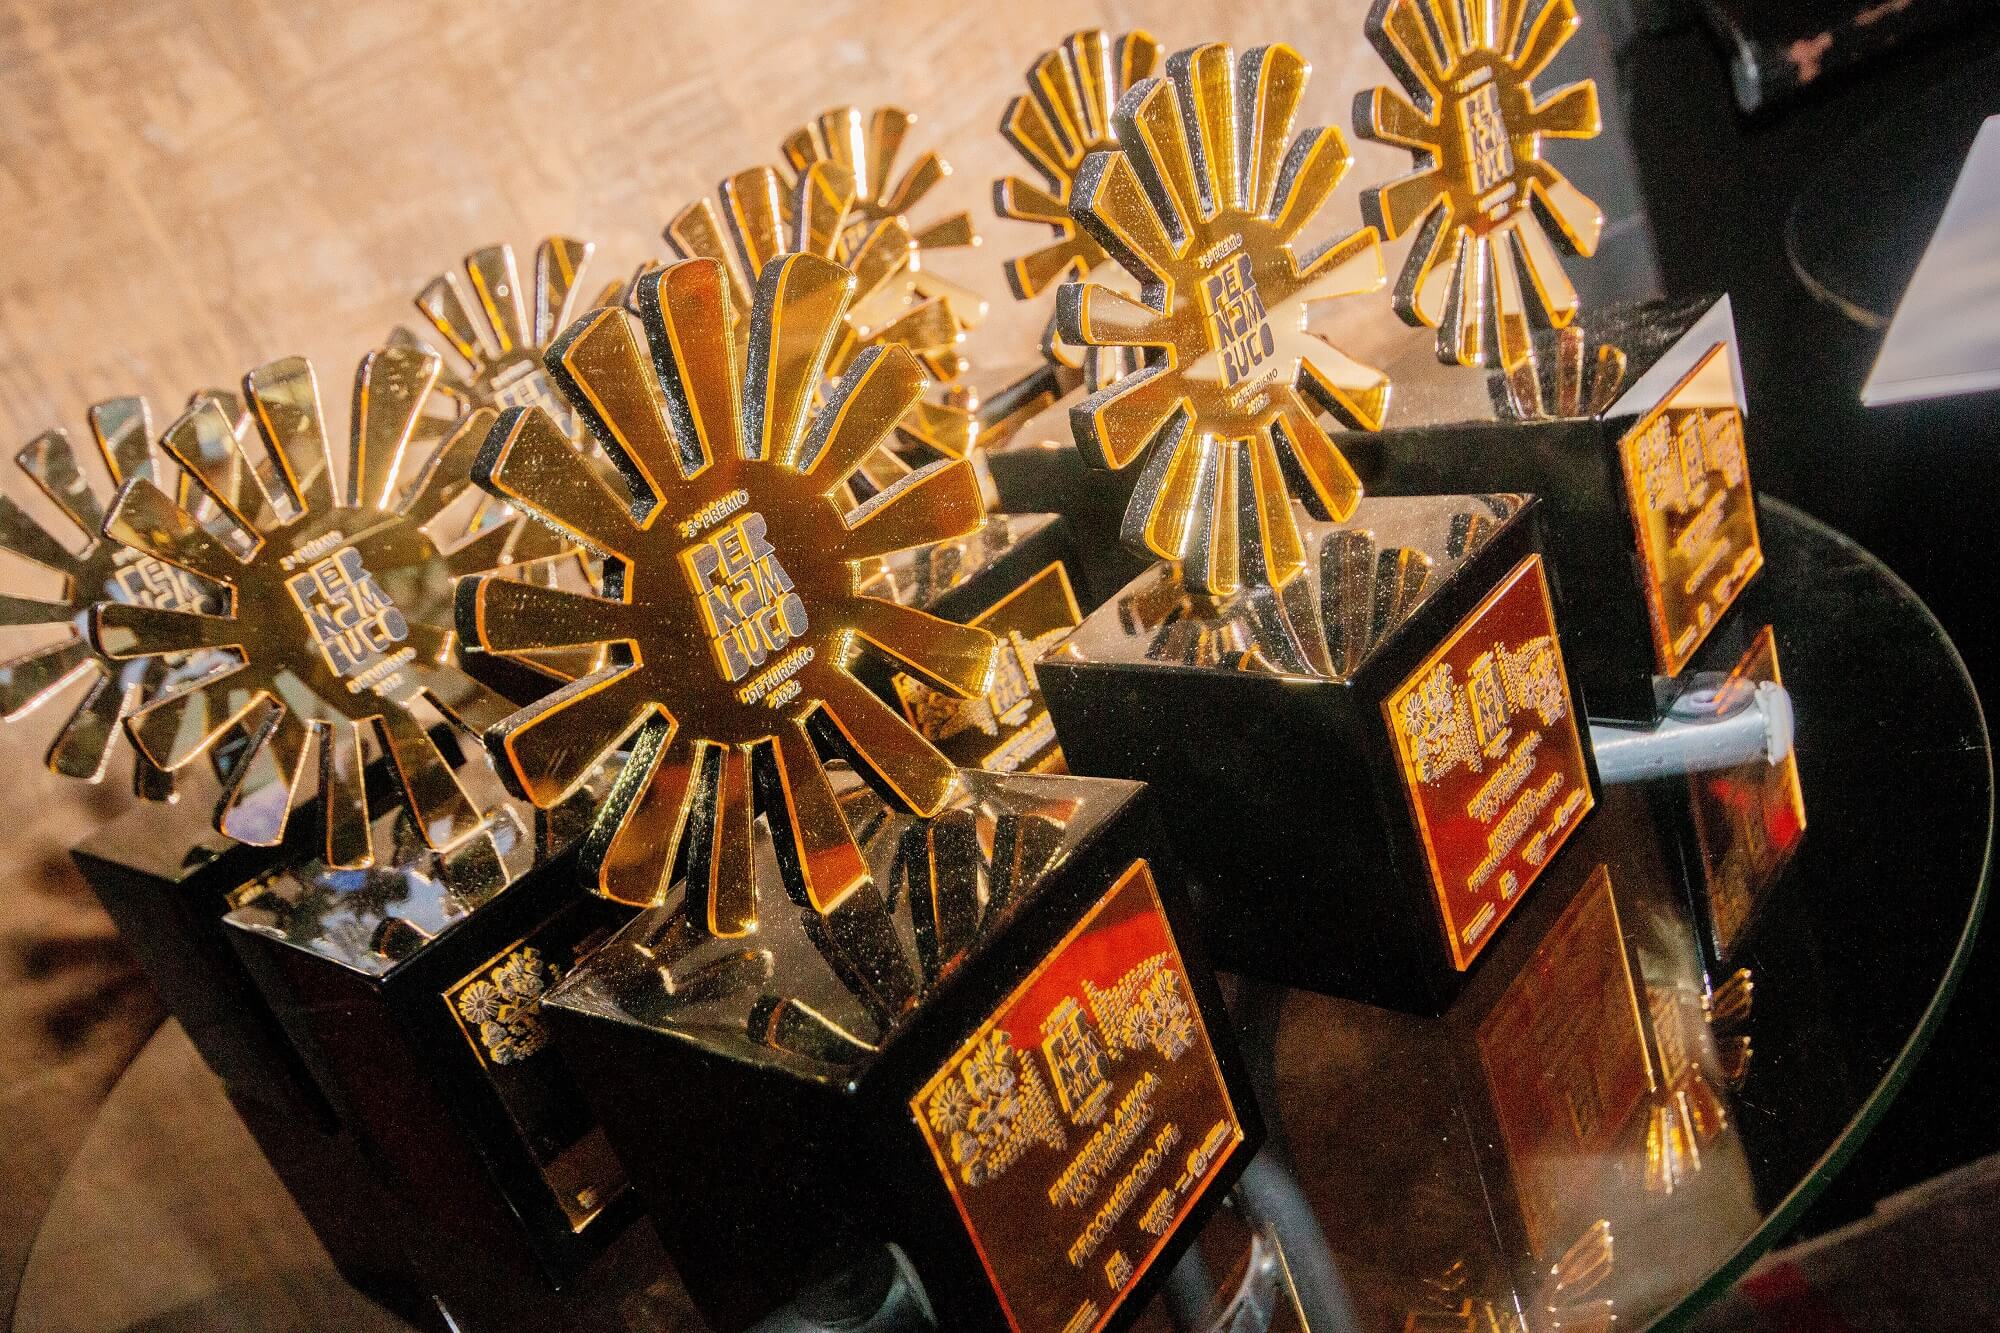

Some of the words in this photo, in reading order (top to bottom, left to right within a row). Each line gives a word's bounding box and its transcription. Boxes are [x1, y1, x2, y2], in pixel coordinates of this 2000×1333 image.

[1200, 253, 1256, 315] PER
[682, 512, 775, 594] PER
[714, 593, 809, 682] BUCO
[757, 646, 816, 693] TURISMO
[766, 679, 802, 709] 2022
[1048, 1119, 1116, 1209] EMPRESA
[1112, 1068, 1161, 1130] AMIGA
